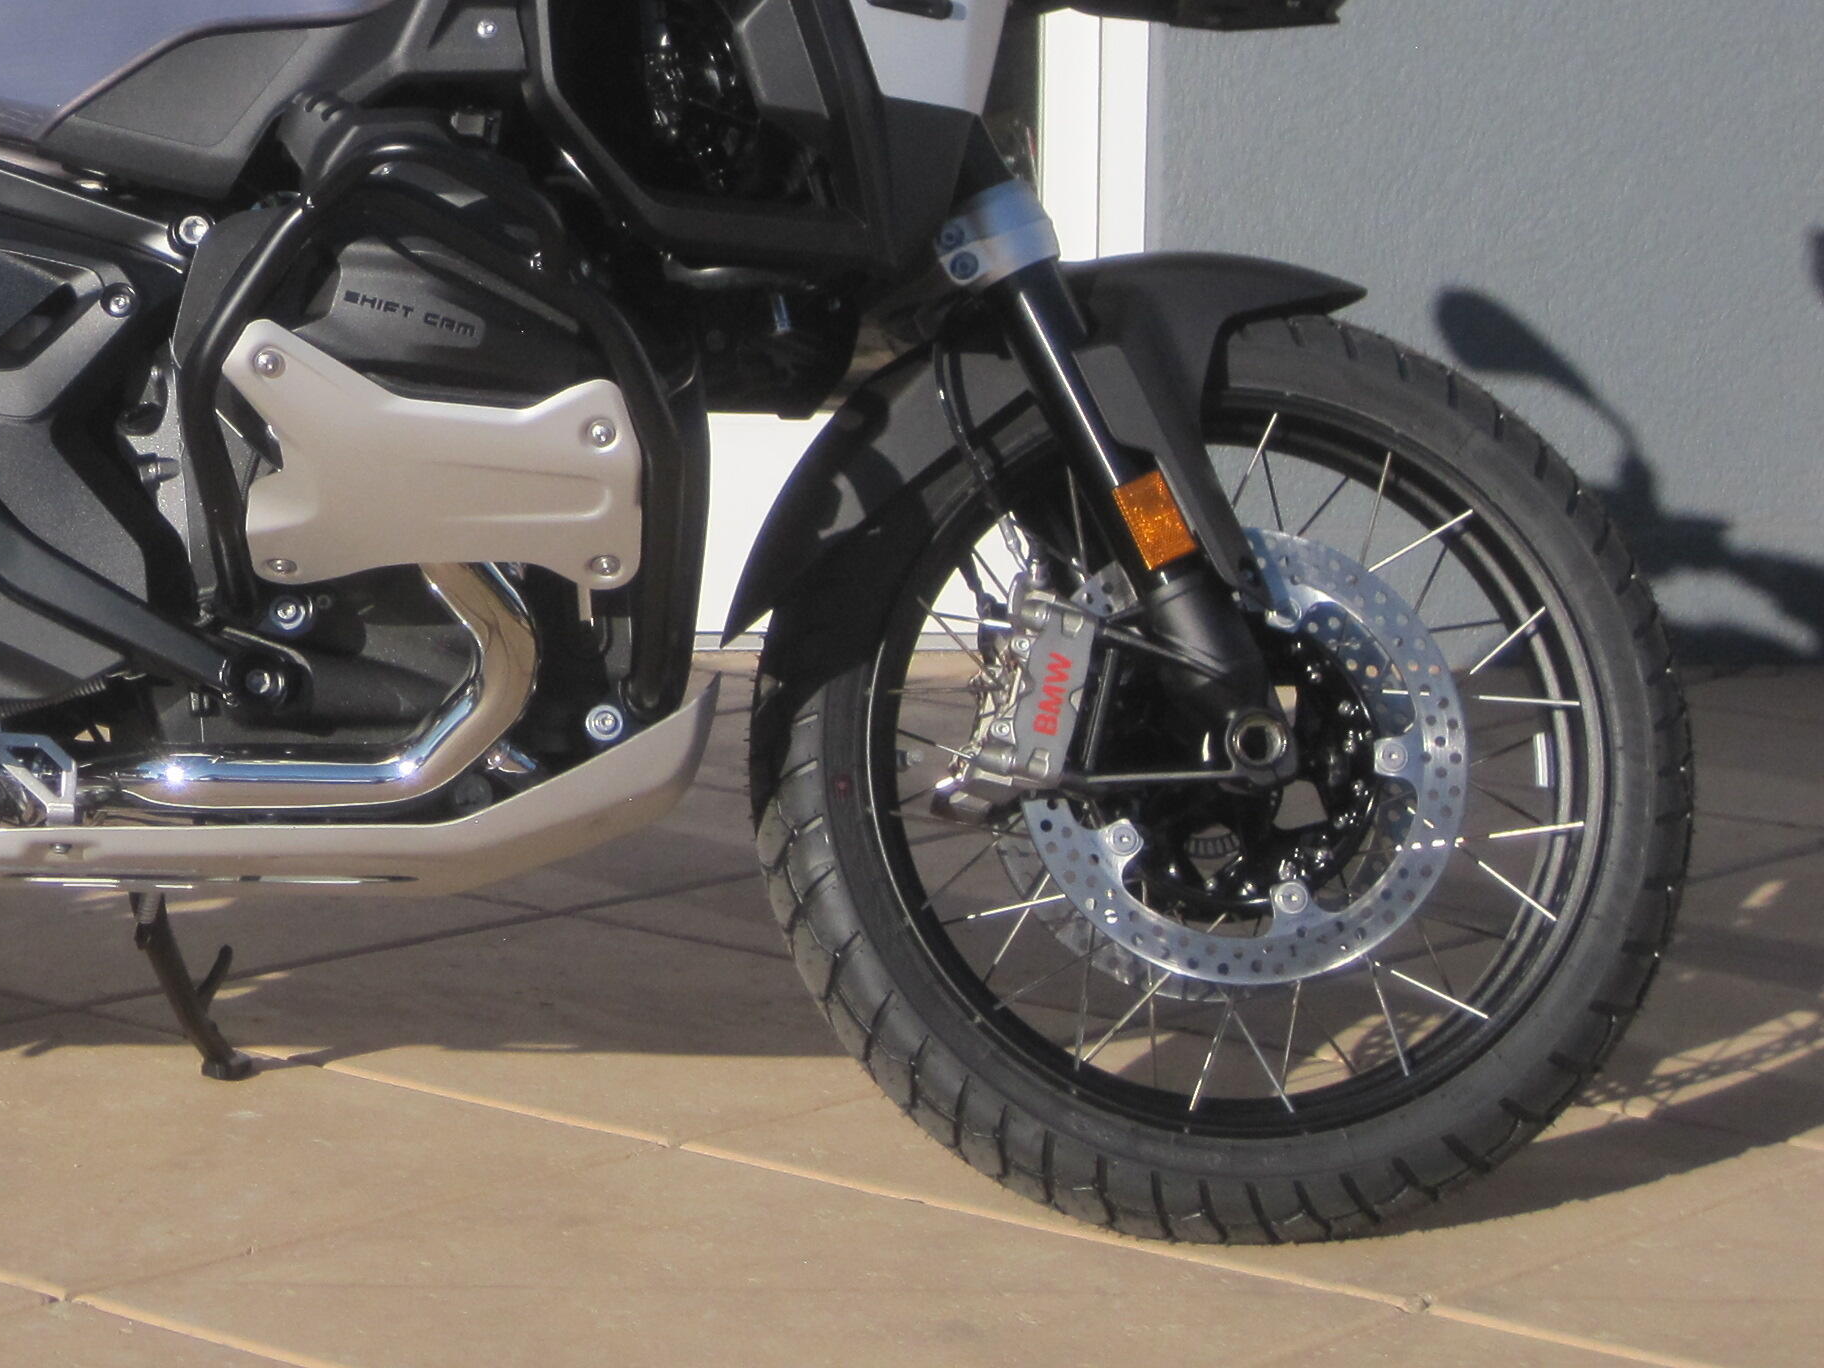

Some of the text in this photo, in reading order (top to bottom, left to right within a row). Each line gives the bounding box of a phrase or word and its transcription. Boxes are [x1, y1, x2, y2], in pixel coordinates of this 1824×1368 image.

[344, 290, 476, 337] SHIFT CAM
[1033, 651, 1073, 737] BMW
